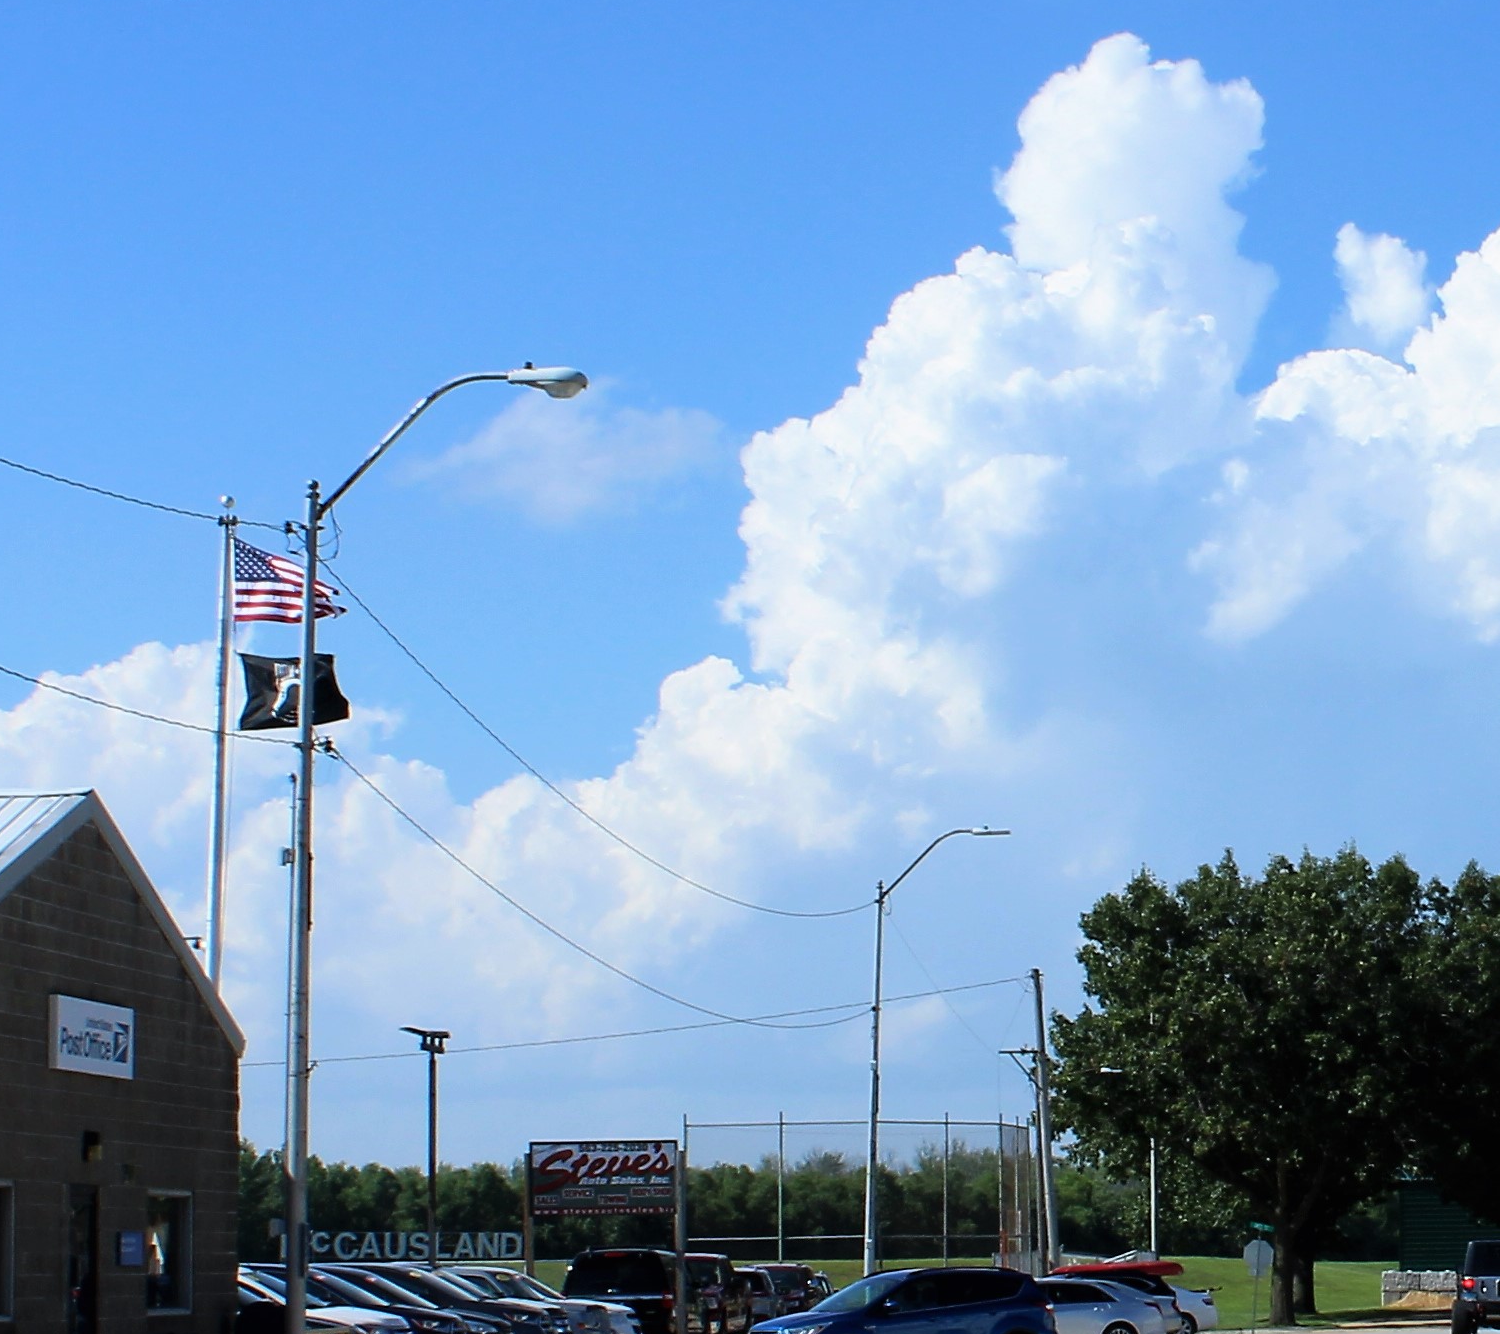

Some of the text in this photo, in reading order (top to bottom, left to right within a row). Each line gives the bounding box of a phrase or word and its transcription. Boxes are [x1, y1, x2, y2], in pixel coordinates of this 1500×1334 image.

[60, 1026, 112, 1061] Post Office
[532, 1142, 674, 1194] Steve's
[579, 1177, 608, 1185] Auto
[280, 1231, 524, 1260] cCAUSLAND
